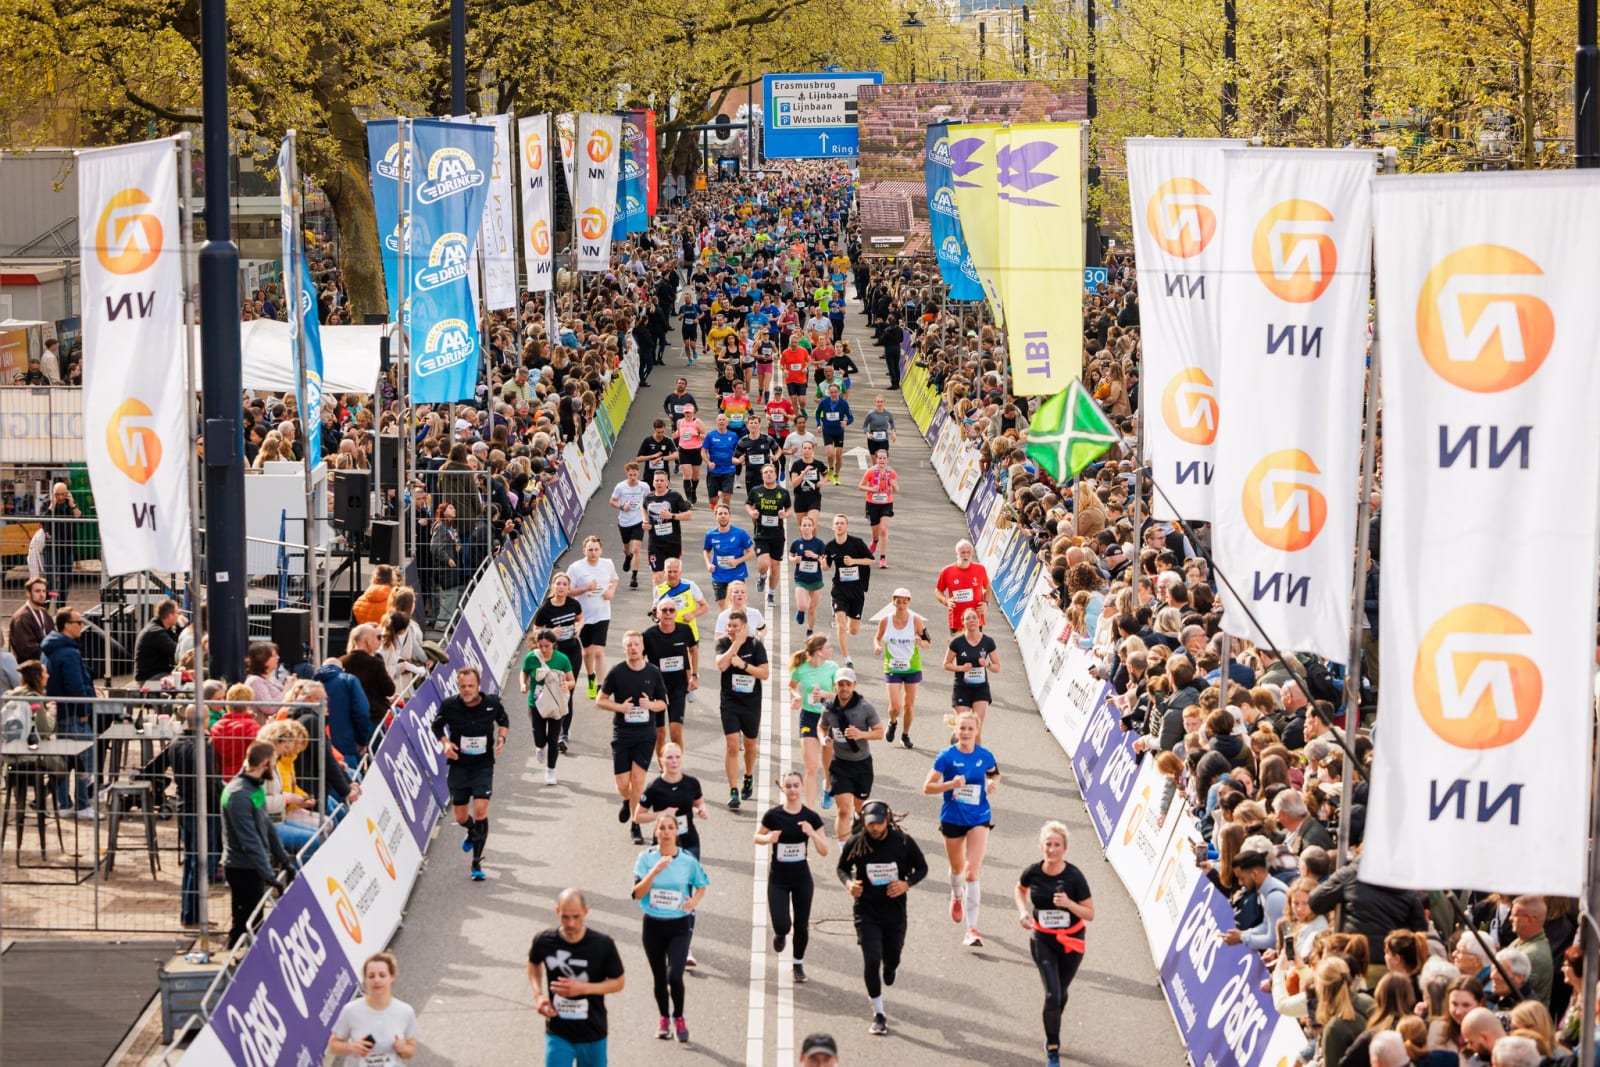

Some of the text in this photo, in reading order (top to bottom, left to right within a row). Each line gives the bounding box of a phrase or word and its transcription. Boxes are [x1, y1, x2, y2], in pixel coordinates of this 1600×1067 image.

[774, 82, 836, 90] Erasmusbrug
[808, 91, 849, 101] Lijnbaan
[793, 102, 833, 111] Lijnbaan
[793, 114, 842, 123] Westblaak
[832, 145, 854, 154] Ring
[441, 158, 466, 180] AA
[588, 167, 605, 180] NN
[436, 174, 471, 196] DRINK
[444, 243, 467, 269] AA
[582, 245, 600, 257] NN
[439, 263, 467, 284] DRIN
[1084, 270, 1105, 283] 30
[441, 330, 467, 354] AA
[437, 348, 468, 368] DRIN
